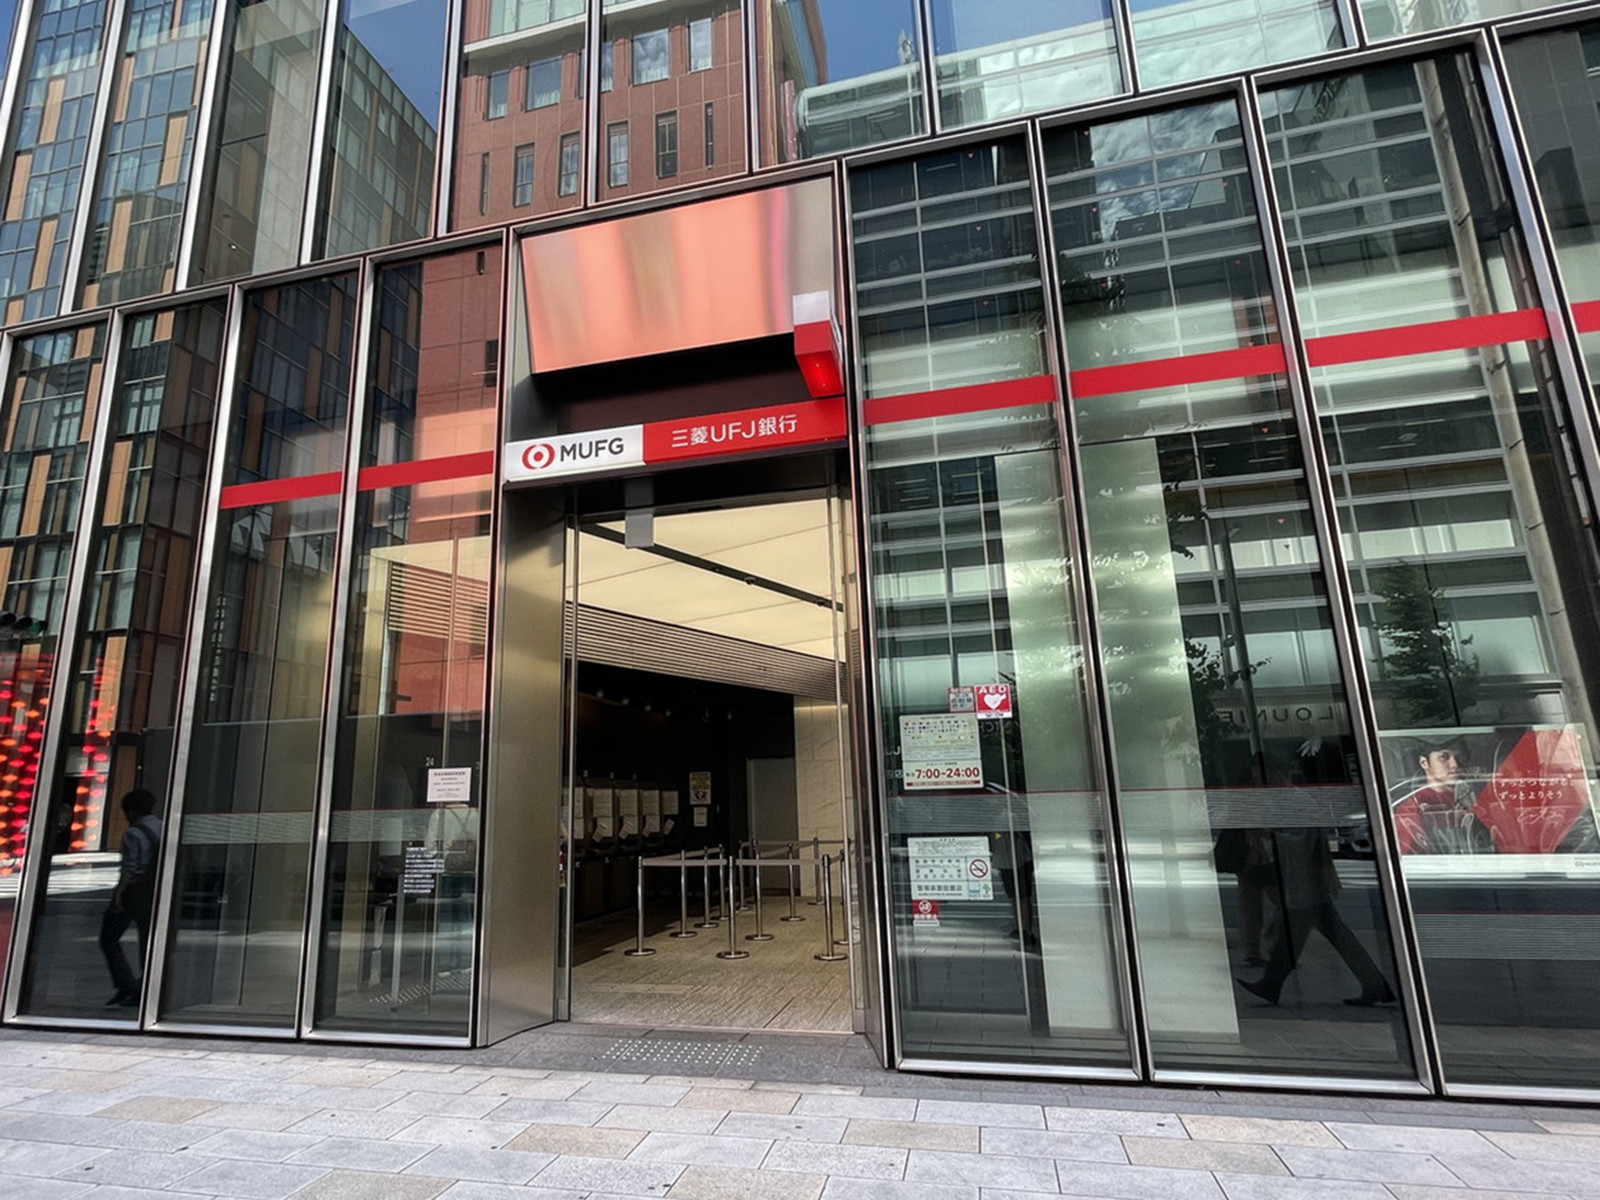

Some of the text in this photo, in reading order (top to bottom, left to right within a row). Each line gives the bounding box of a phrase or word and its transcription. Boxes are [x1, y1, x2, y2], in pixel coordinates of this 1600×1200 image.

[671, 414, 798, 448] 三菱UFJ銀行
[560, 437, 624, 462] MUFG
[978, 684, 1008, 695] AED
